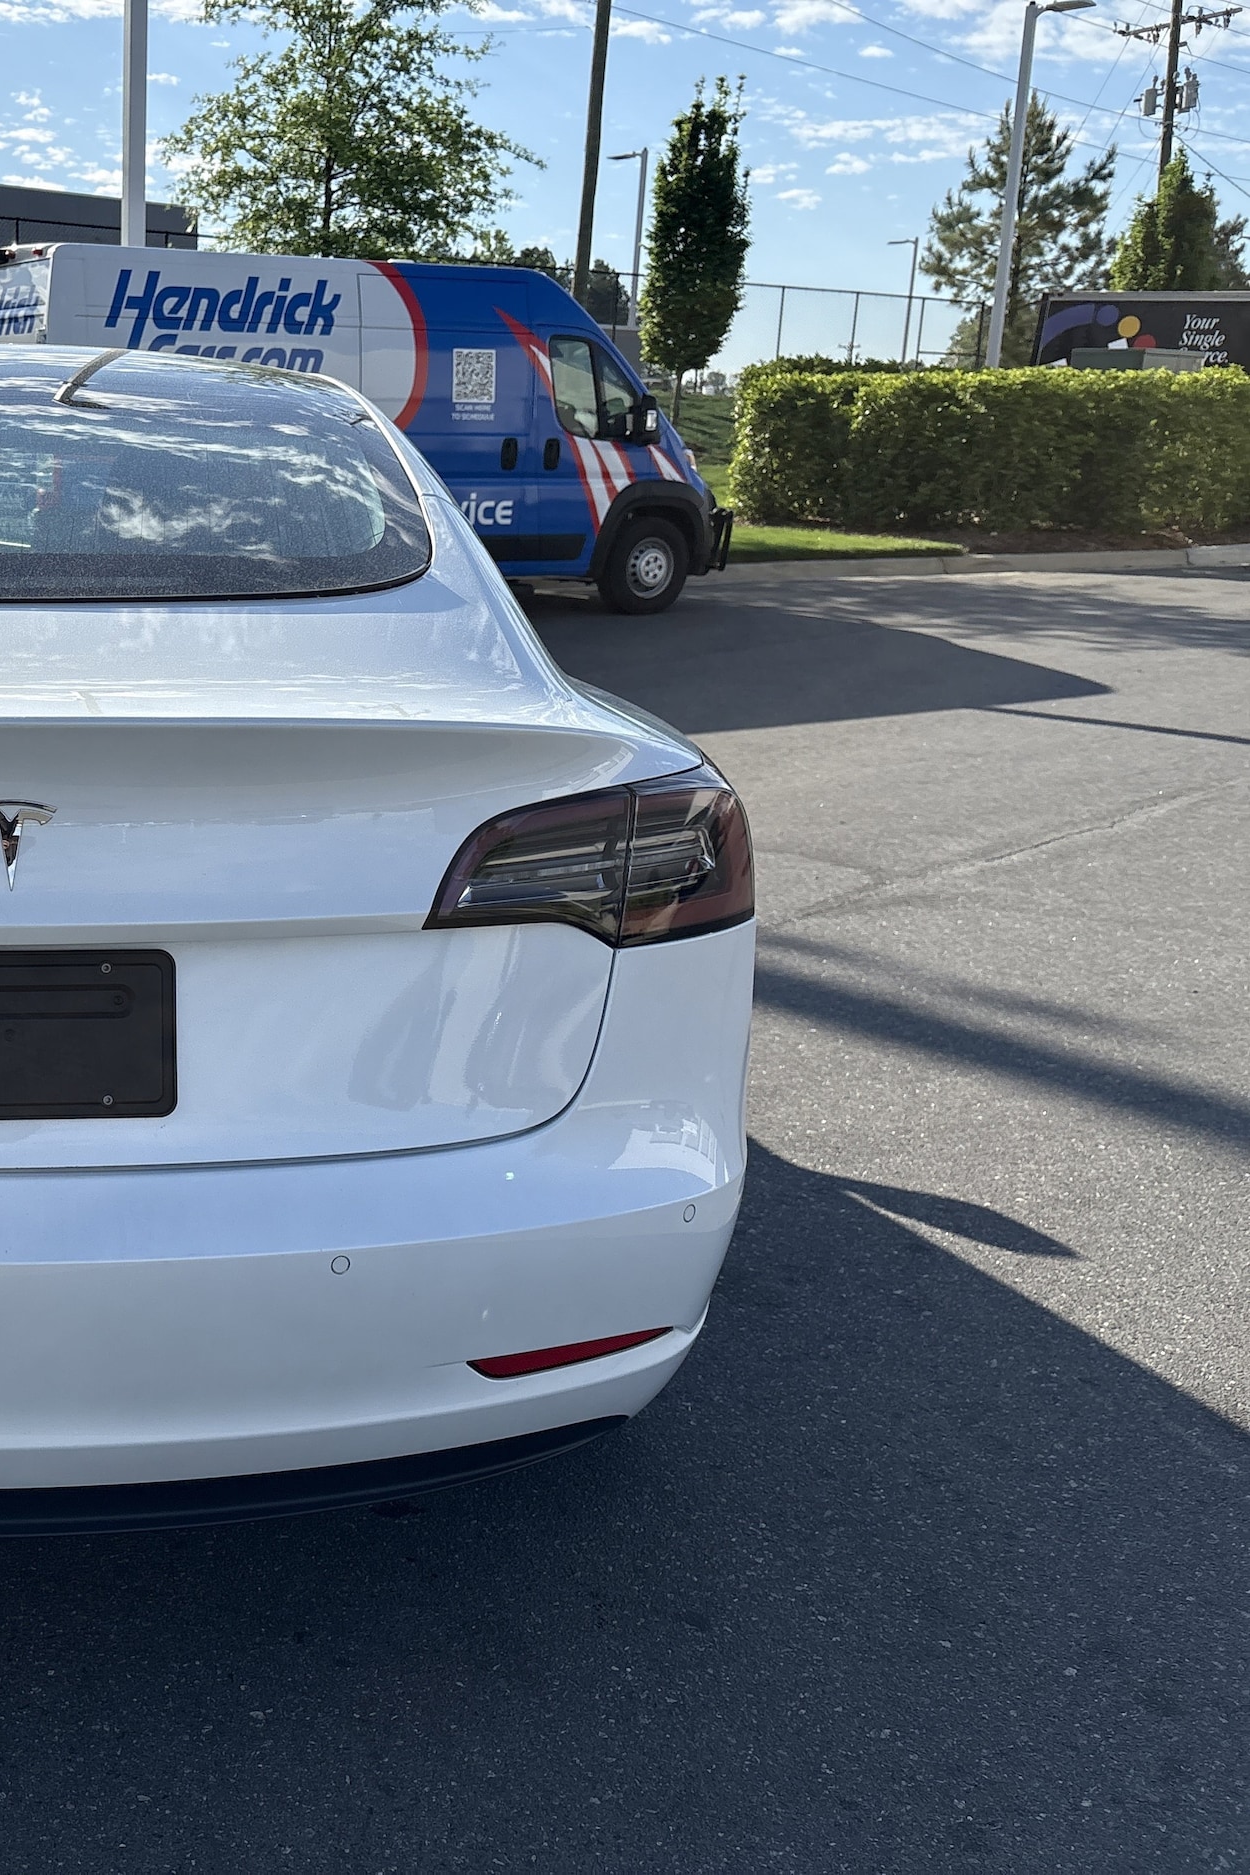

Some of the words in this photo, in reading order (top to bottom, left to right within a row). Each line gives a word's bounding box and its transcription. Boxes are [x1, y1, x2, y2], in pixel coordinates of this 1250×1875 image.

[104, 269, 341, 349] Hendrick
[1183, 313, 1220, 330] Your
[1178, 329, 1226, 350] Single
